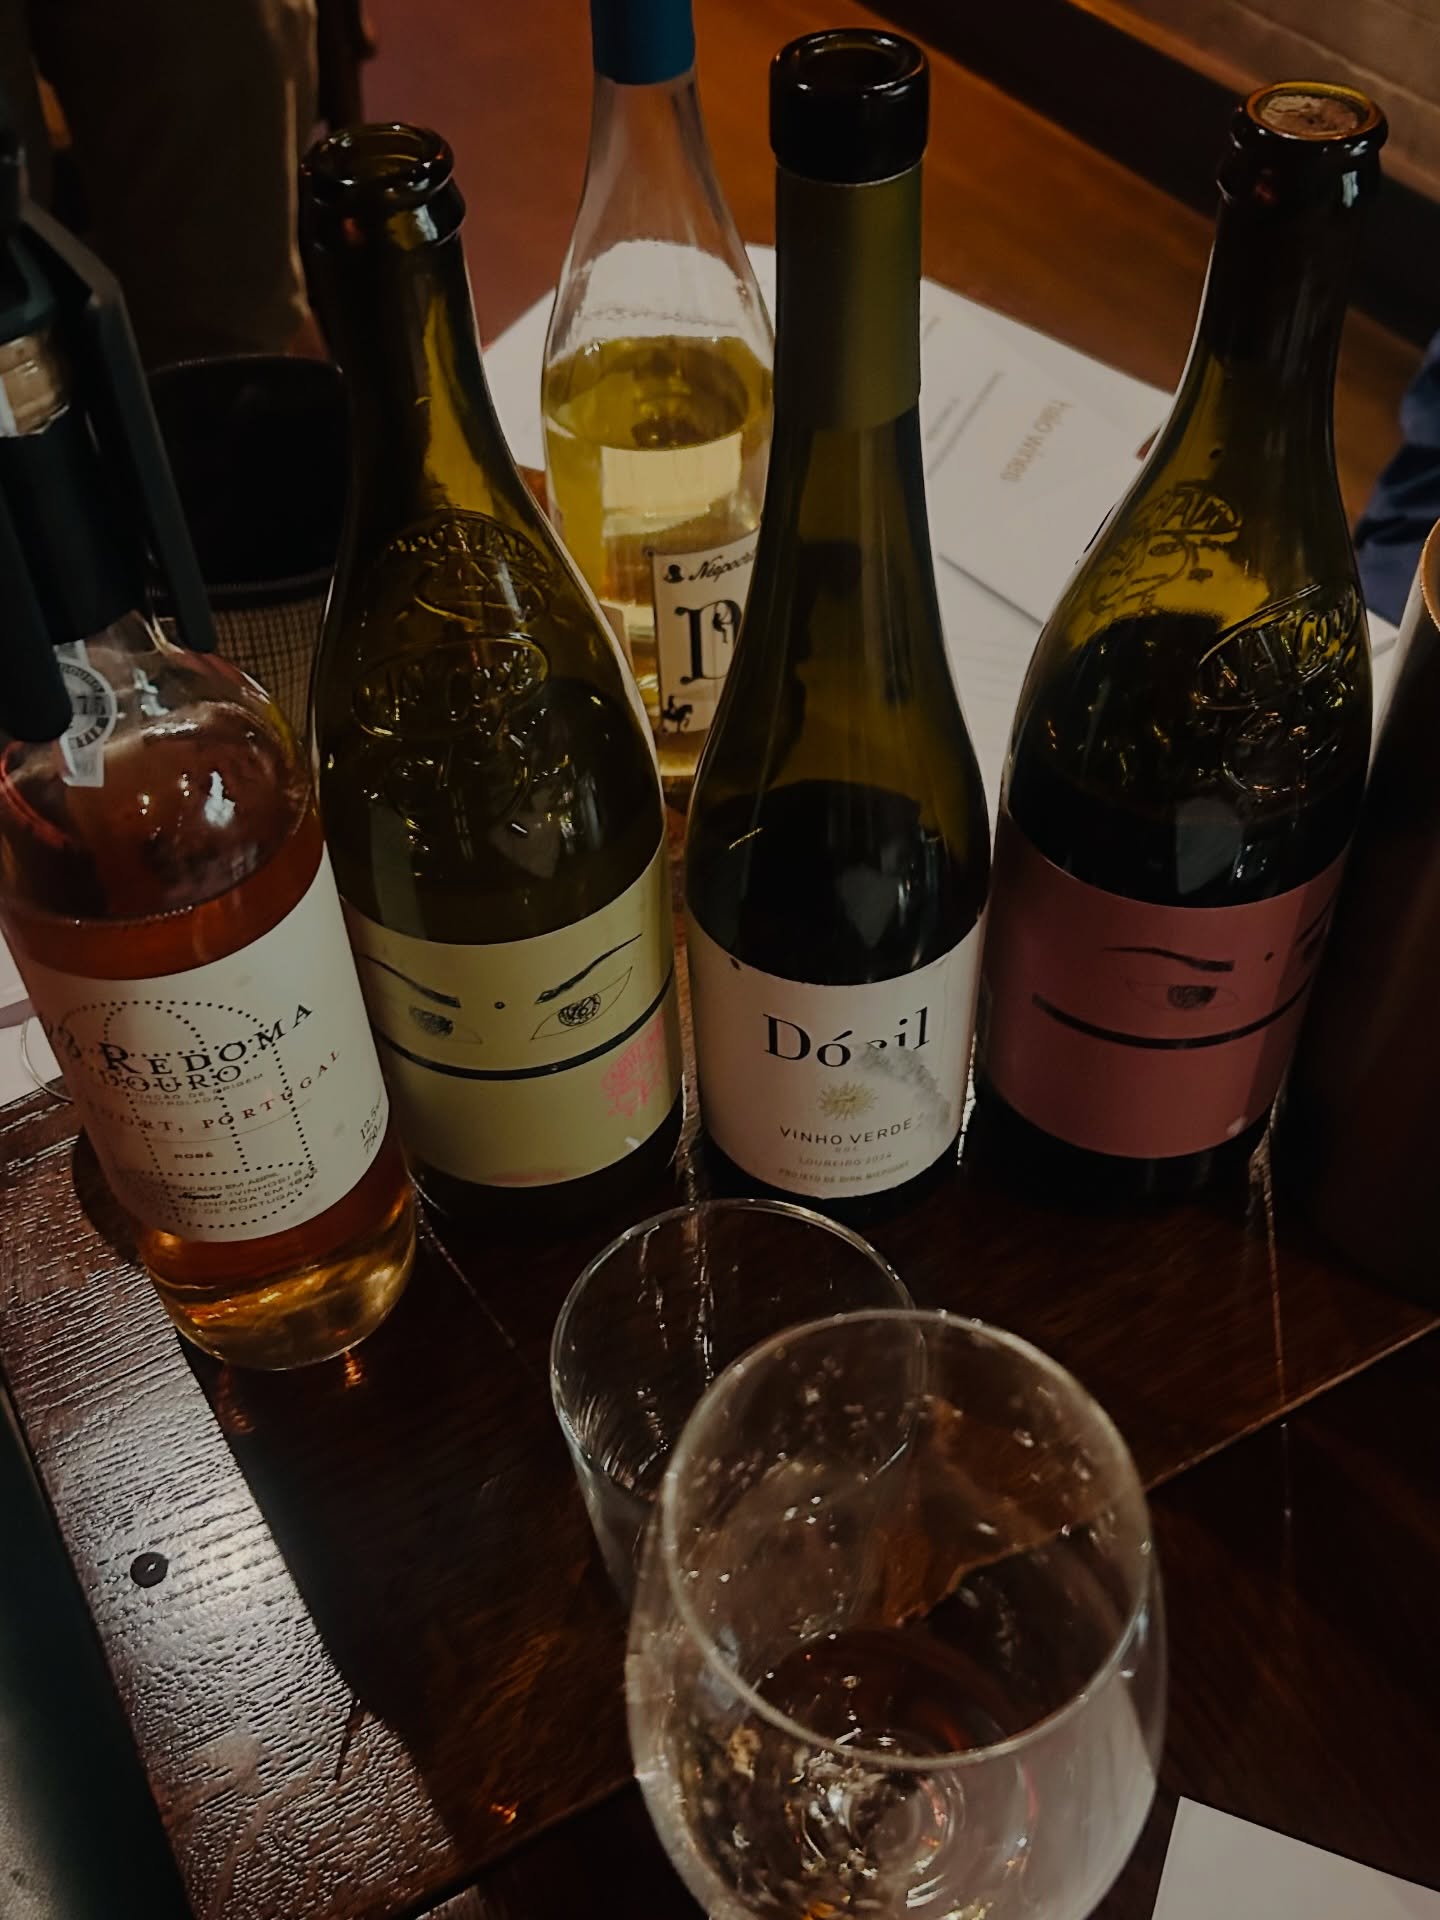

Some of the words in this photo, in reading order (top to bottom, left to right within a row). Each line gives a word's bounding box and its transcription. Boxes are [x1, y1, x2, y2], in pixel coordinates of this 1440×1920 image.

[97, 1003, 313, 1074] REDOMA
[99, 1065, 241, 1093] DOURO
[202, 1050, 341, 1129] PORTUGAL
[779, 1126, 843, 1146] VINHO
[849, 1118, 913, 1145] VERDE
